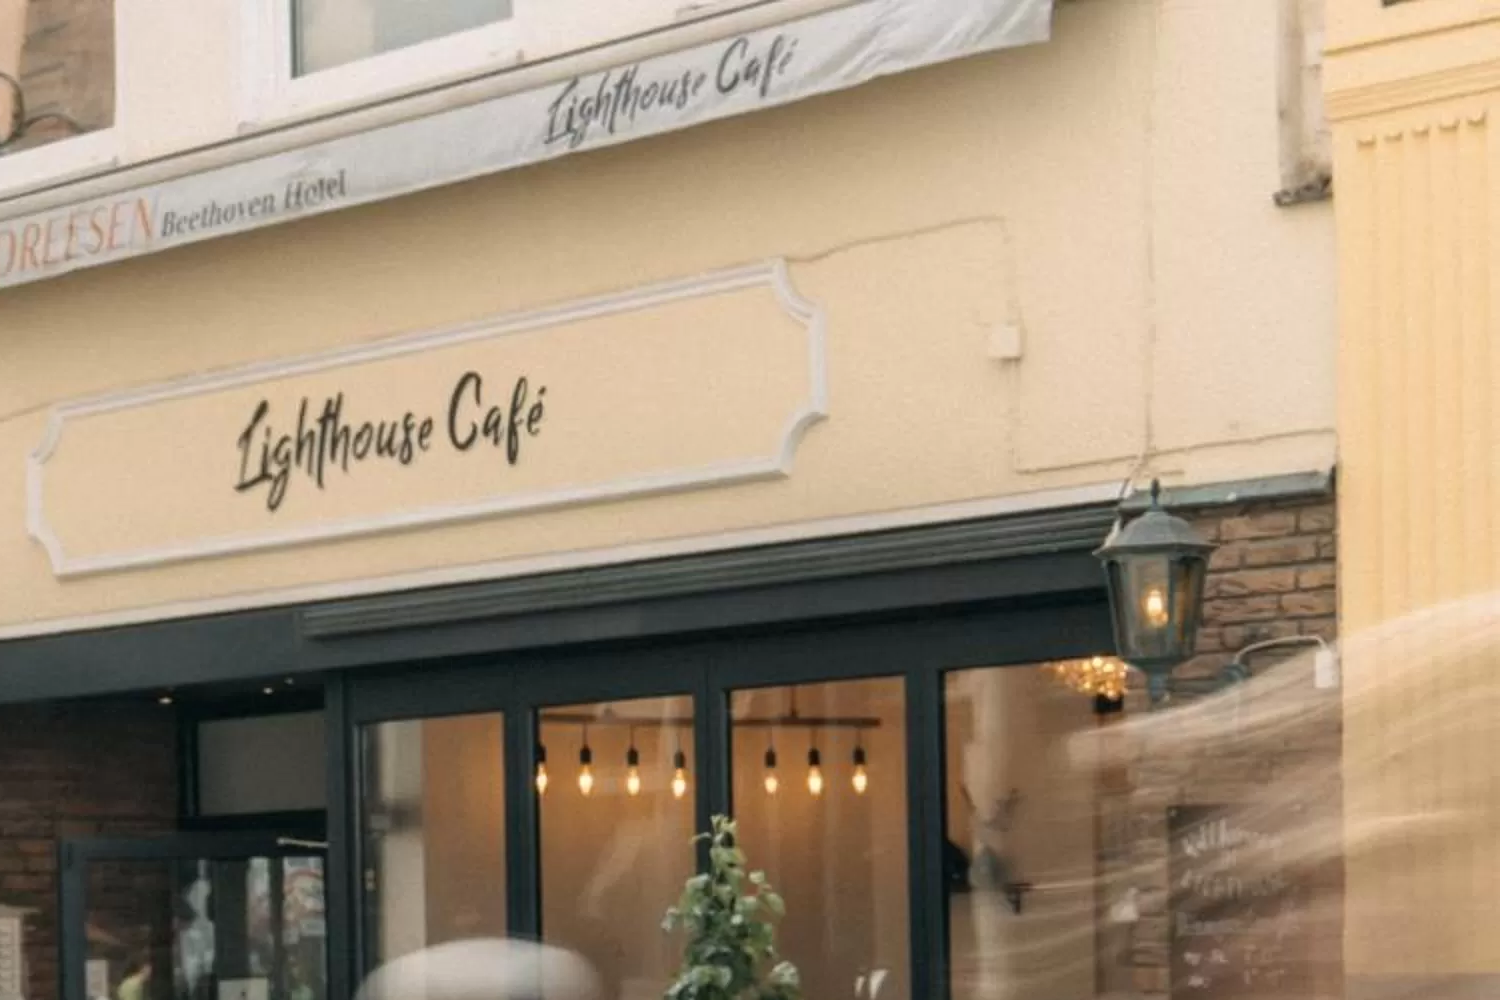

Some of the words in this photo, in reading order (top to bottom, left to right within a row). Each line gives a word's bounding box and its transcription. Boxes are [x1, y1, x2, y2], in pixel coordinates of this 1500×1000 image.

[543, 63, 707, 148] Lighthouse
[715, 34, 799, 98] Café
[160, 192, 276, 237] Beethoven
[285, 168, 346, 210] Hotel
[234, 391, 433, 512] Lighthouse
[449, 371, 546, 465] Café
